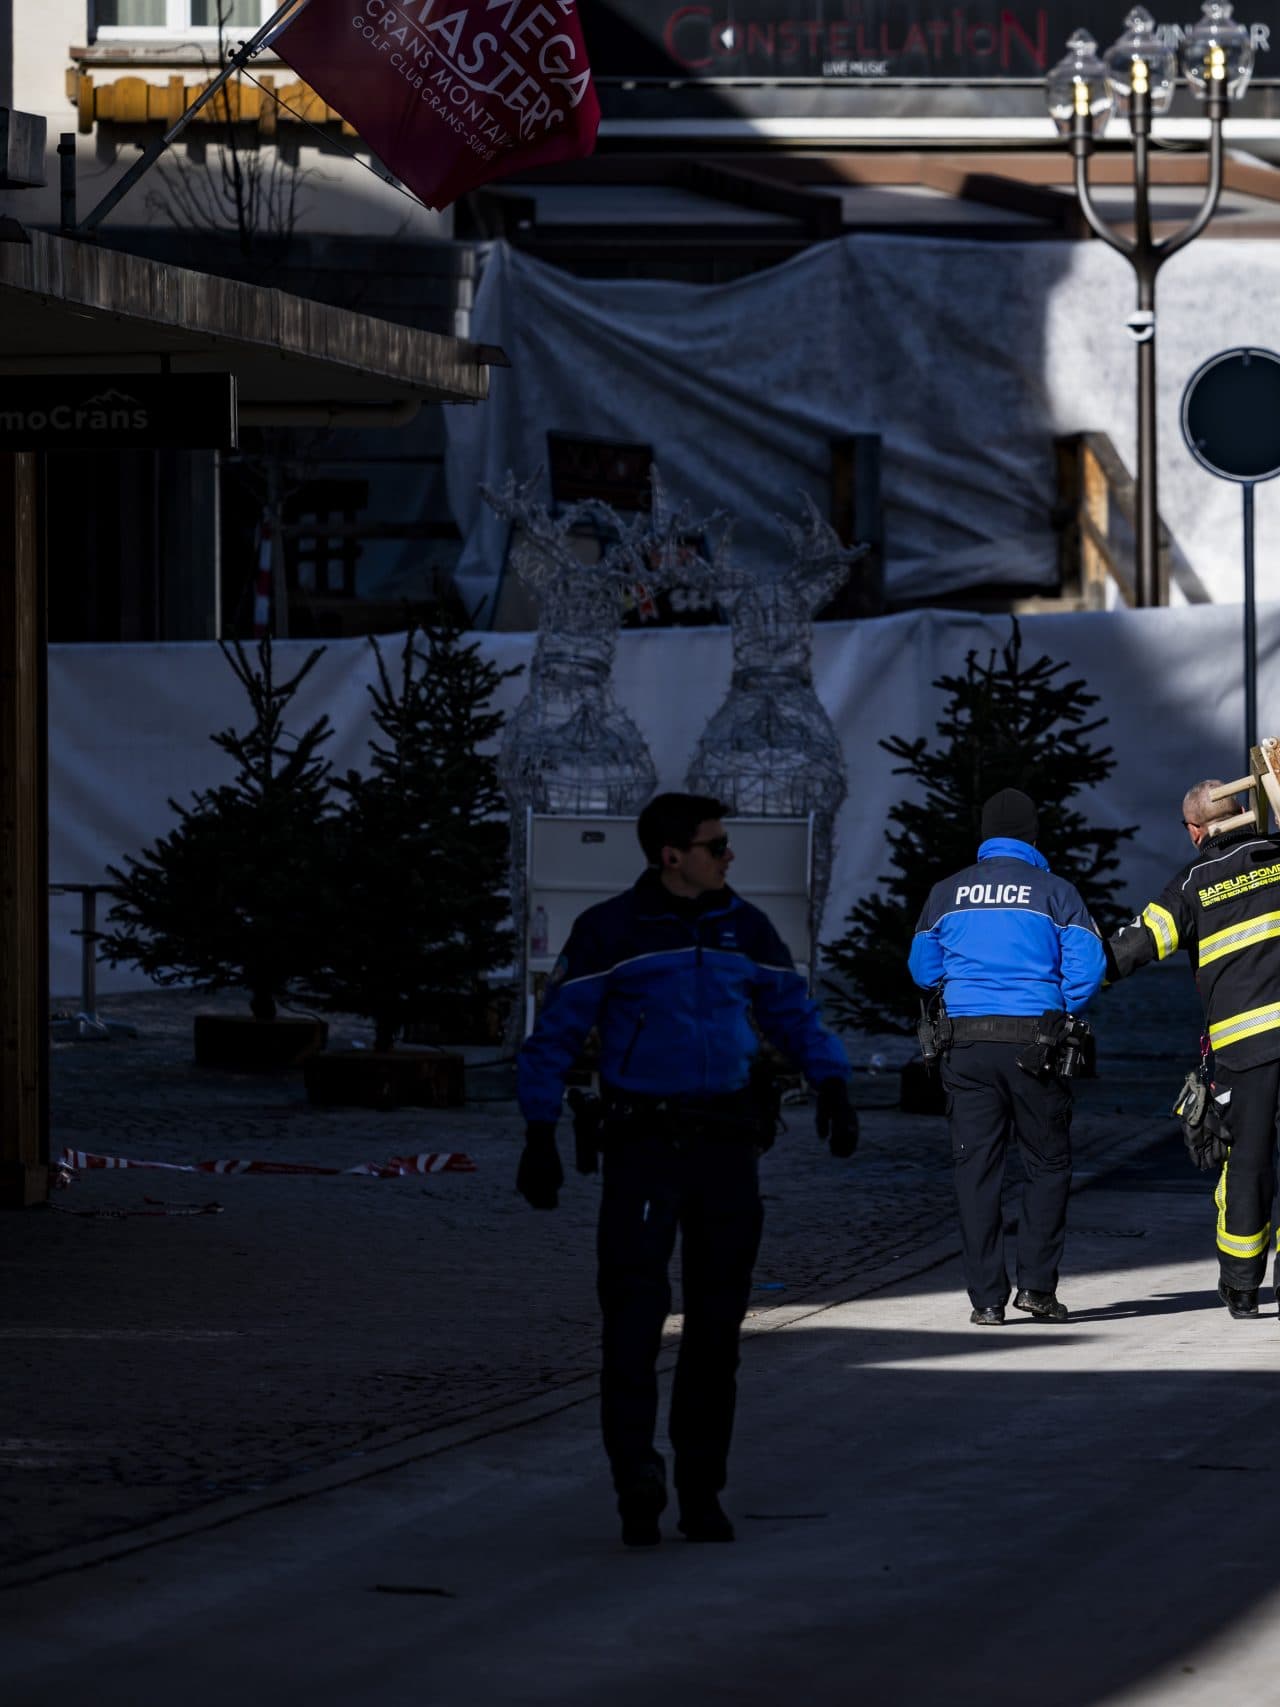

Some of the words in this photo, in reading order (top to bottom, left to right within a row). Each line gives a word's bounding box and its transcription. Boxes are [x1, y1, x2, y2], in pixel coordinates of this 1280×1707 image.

[352, 15, 390, 52] GOLF
[390, 53, 423, 89] CLUB
[366, 0, 433, 69] CRANS
[955, 884, 1032, 905] POLICE
